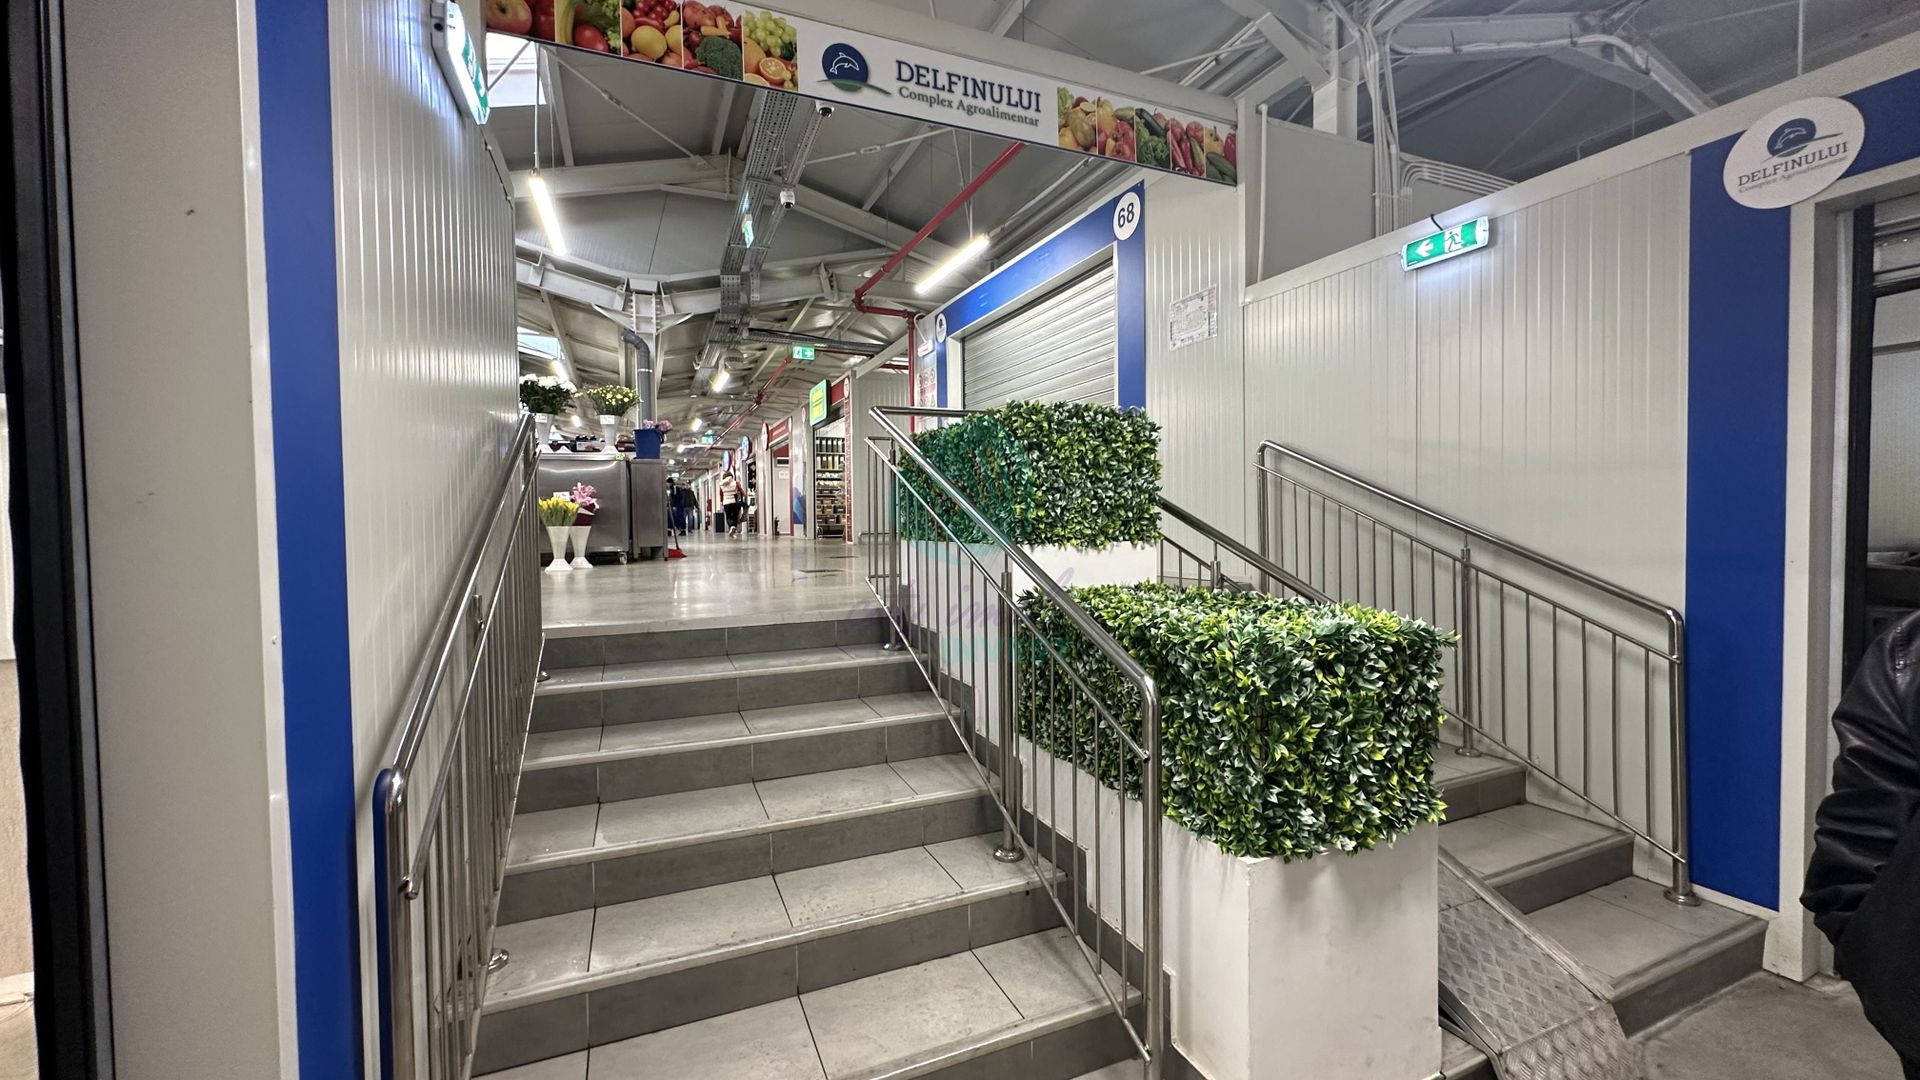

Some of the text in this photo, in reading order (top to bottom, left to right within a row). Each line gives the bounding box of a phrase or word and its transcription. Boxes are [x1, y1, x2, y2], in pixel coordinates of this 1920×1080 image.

[895, 59, 1041, 113] DELFINULUI
[898, 86, 1040, 127] Complex Agroalimentar
[1737, 141, 1848, 187] DELFINULUI
[1117, 202, 1134, 228] 68
